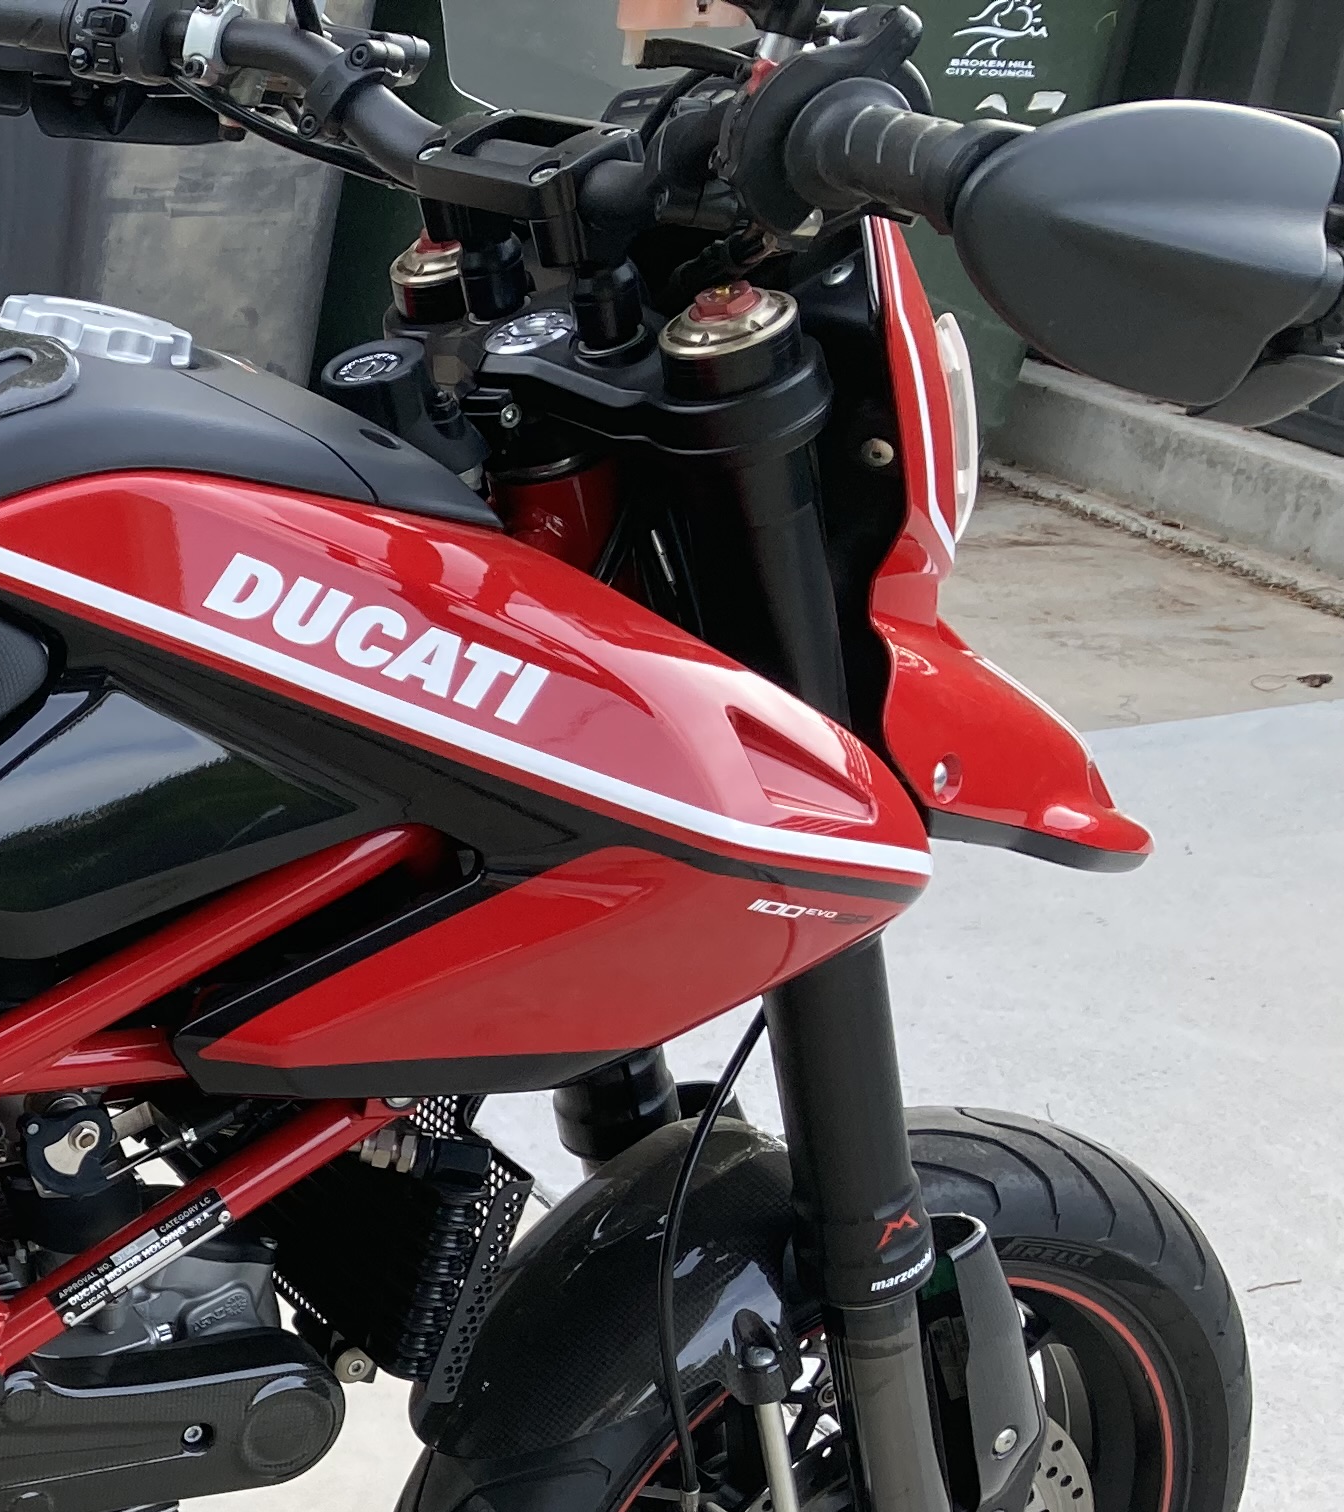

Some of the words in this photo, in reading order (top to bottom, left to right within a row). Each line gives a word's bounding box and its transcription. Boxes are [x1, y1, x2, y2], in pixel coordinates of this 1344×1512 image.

[945, 67, 976, 76] CITY
[978, 69, 1035, 78] COUNCIL
[950, 58, 1006, 67] BROKEN
[1008, 60, 1035, 69] HILL
[202, 552, 550, 725] DUCATI
[747, 898, 807, 918] 1100
[805, 908, 838, 918] EVO
[57, 1269, 97, 1299] APPROVAL
[158, 1203, 199, 1233] CATEGORY
[198, 1195, 211, 1207] LC
[67, 1277, 106, 1306] DUCATI
[104, 1253, 142, 1282] MOTOR
[140, 1224, 187, 1259] HOLDING
[80, 1288, 108, 1310] DUCATI
